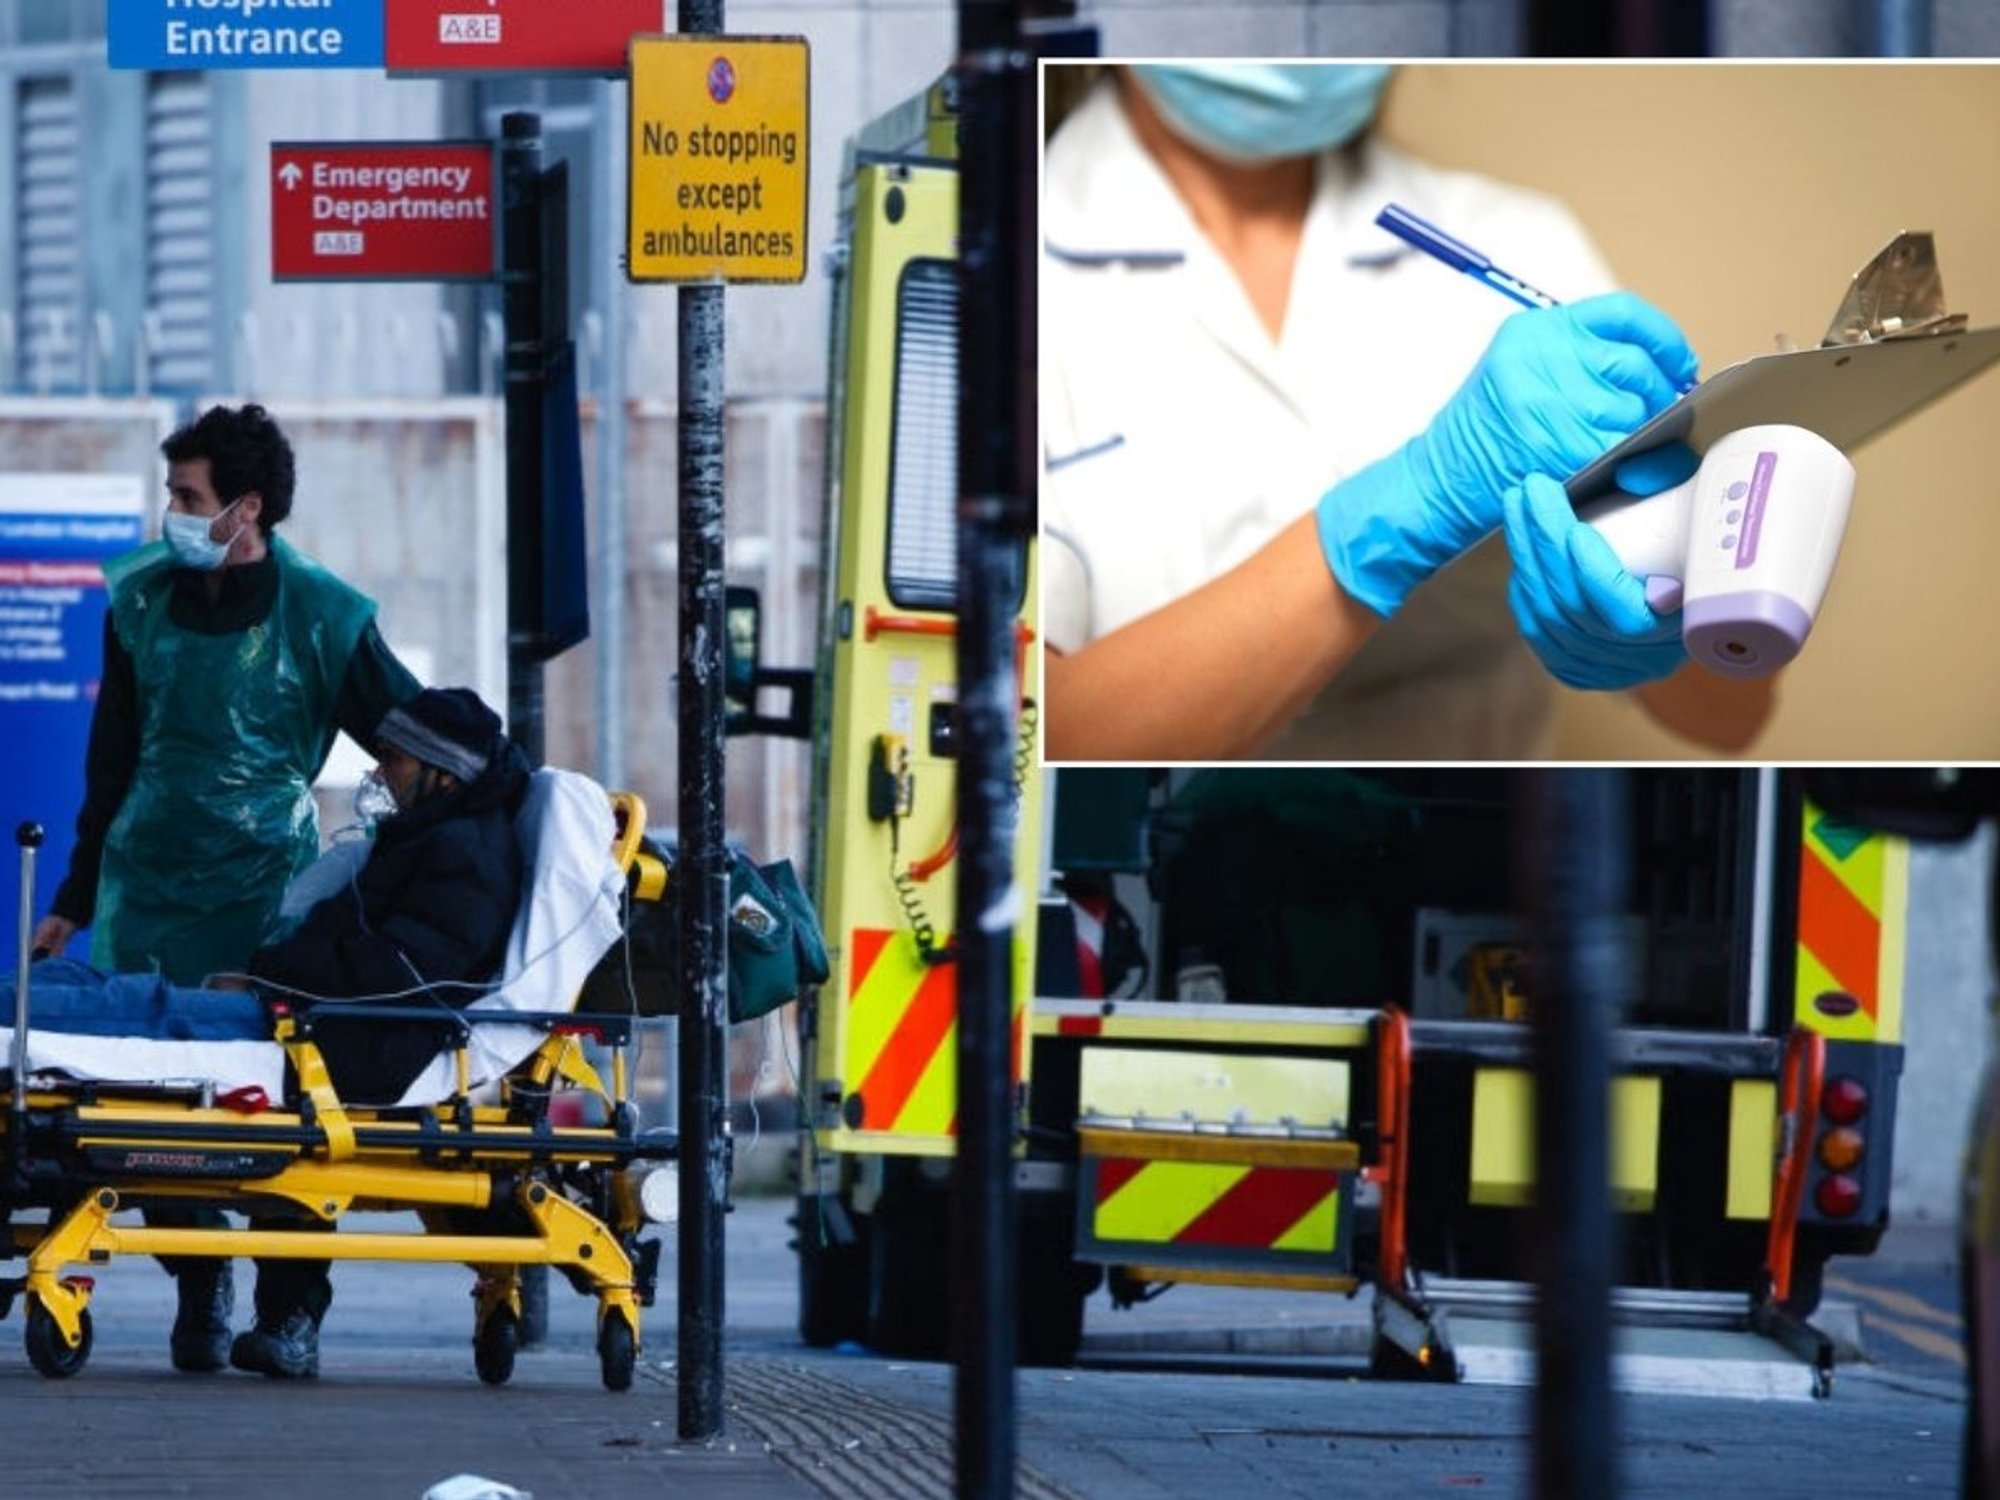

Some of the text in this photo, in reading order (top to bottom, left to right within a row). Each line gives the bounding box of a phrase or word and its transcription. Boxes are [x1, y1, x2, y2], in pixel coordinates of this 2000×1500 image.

[166, 21, 342, 55] Entrance
[443, 18, 497, 39] A&E
[642, 121, 797, 165] No stopping
[312, 162, 471, 193] Emergency
[312, 195, 488, 226] Department
[677, 176, 763, 216] except
[643, 222, 794, 257] ambulances
